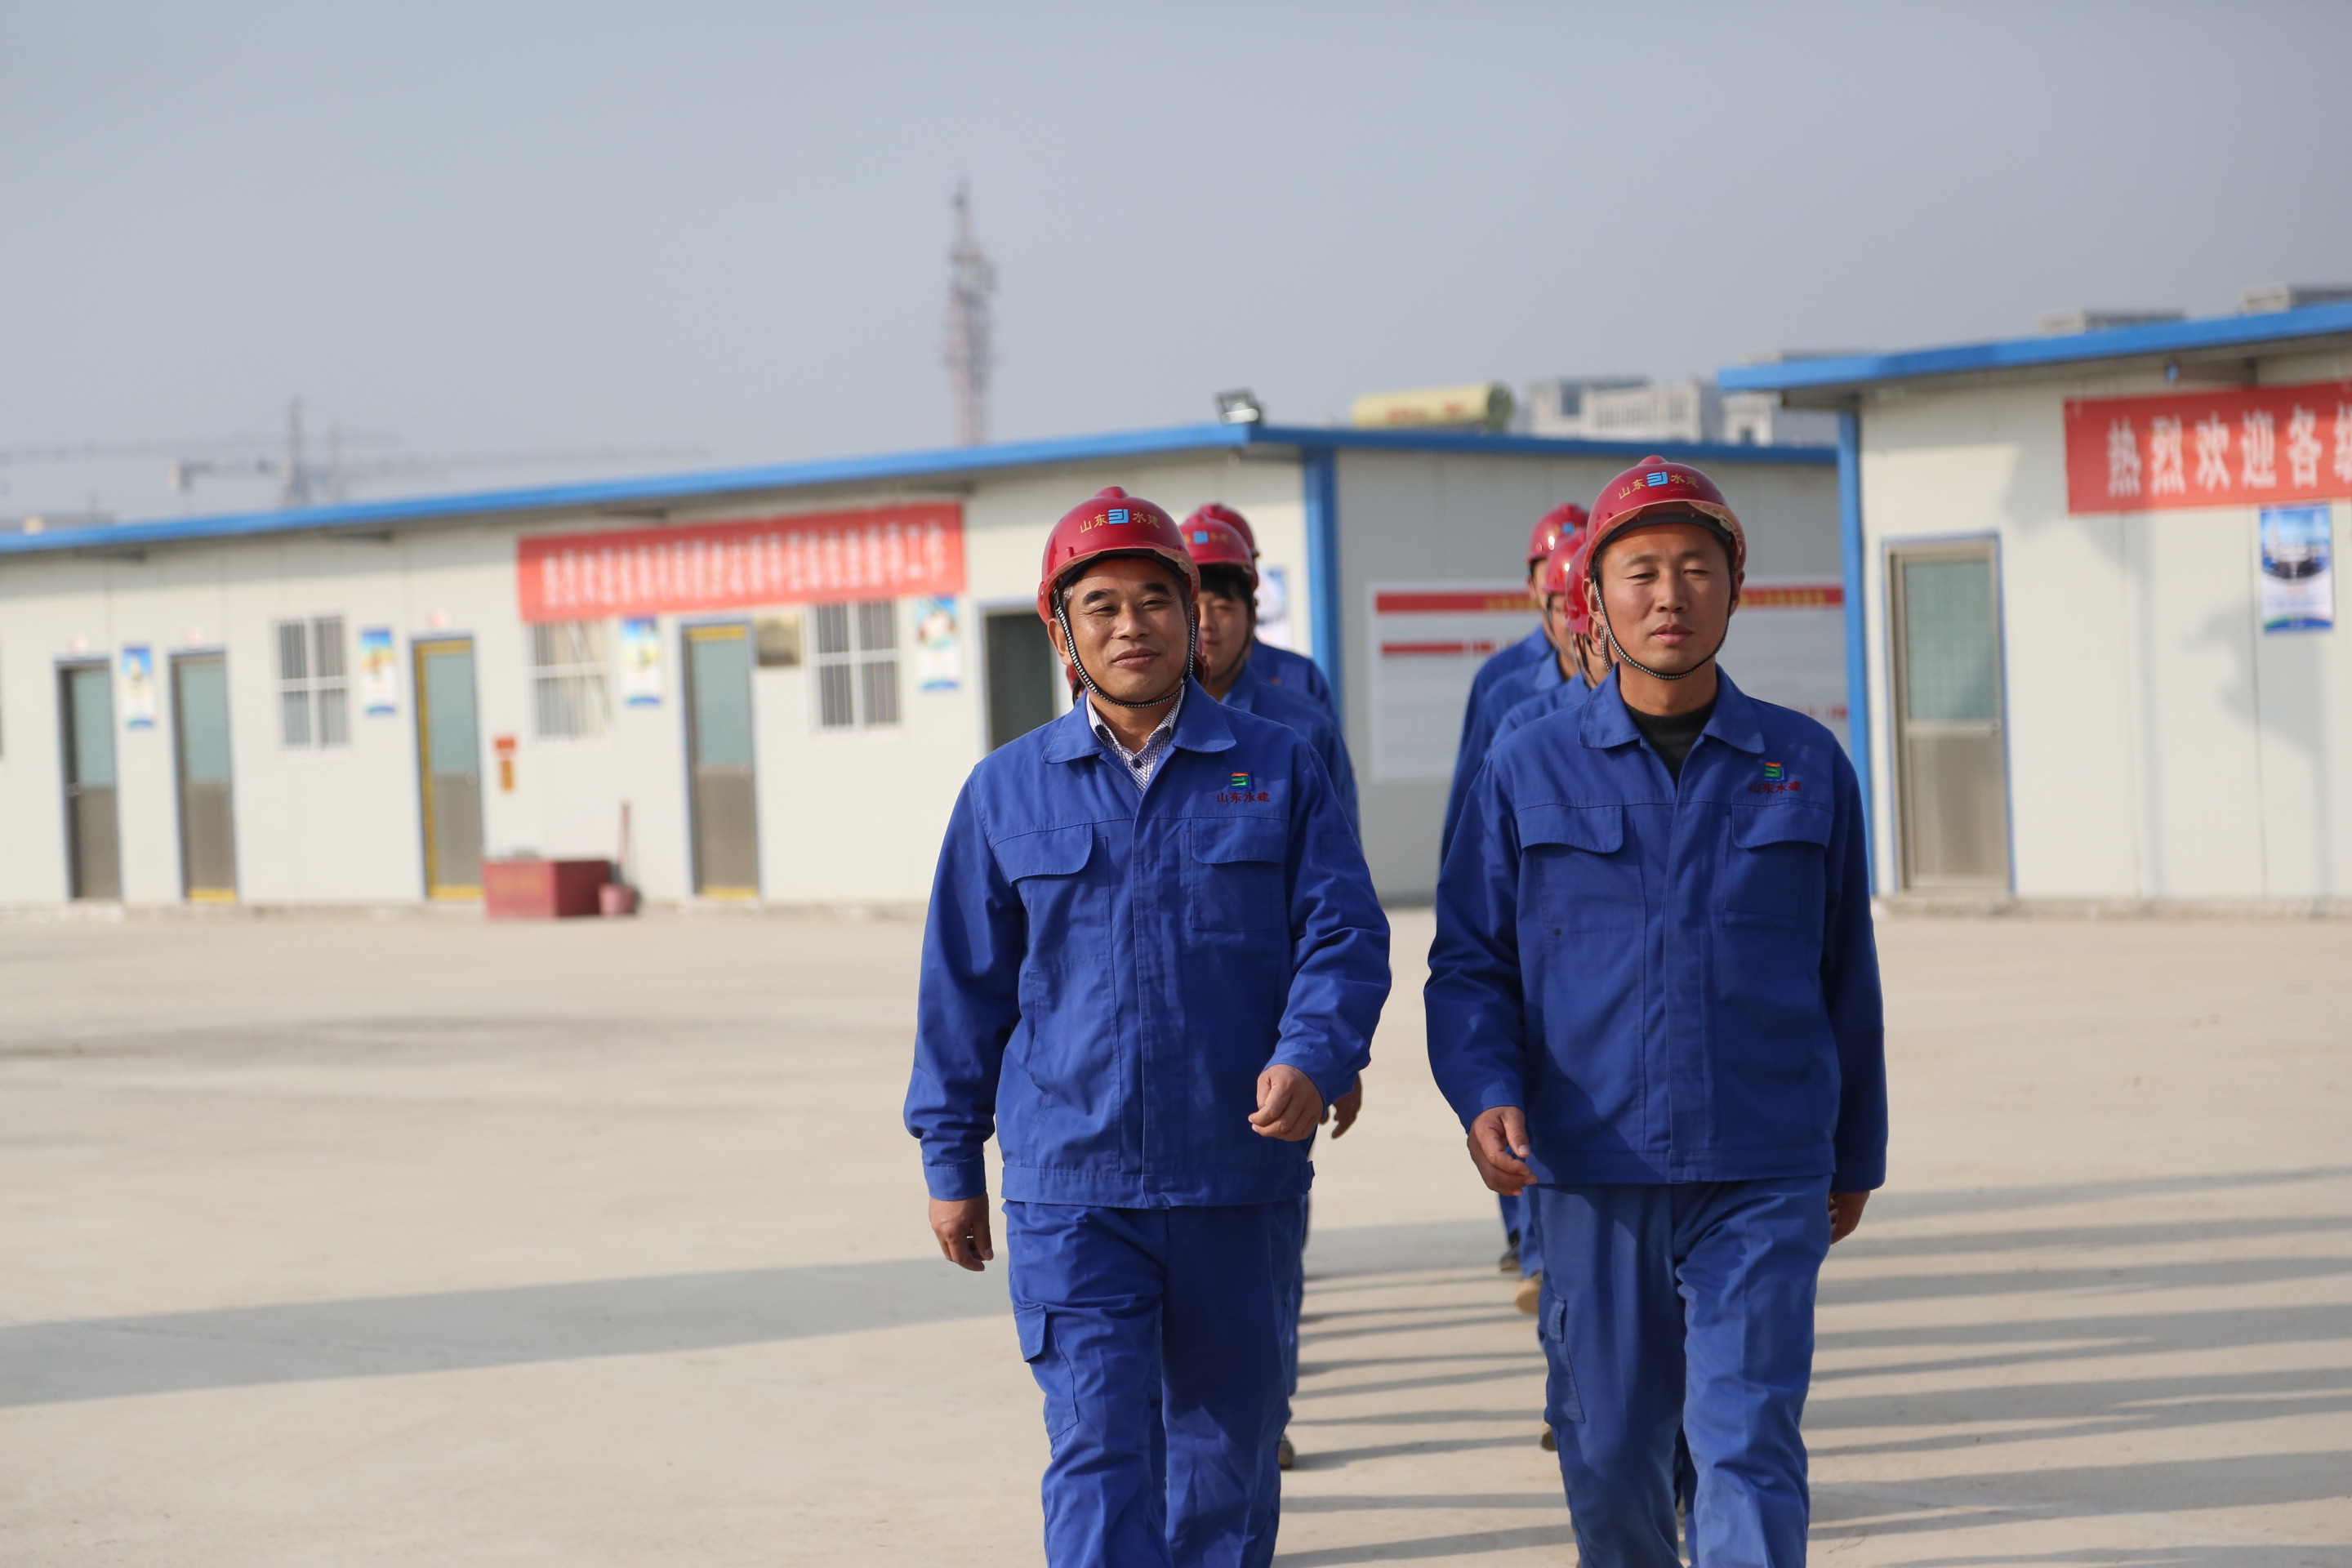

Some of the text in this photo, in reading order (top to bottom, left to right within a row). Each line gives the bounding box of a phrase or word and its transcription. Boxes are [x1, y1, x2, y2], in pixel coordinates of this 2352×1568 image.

[1619, 479, 1646, 500] 山东
[1080, 514, 1108, 533] 山东
[1216, 791, 1270, 803] 山东水建
